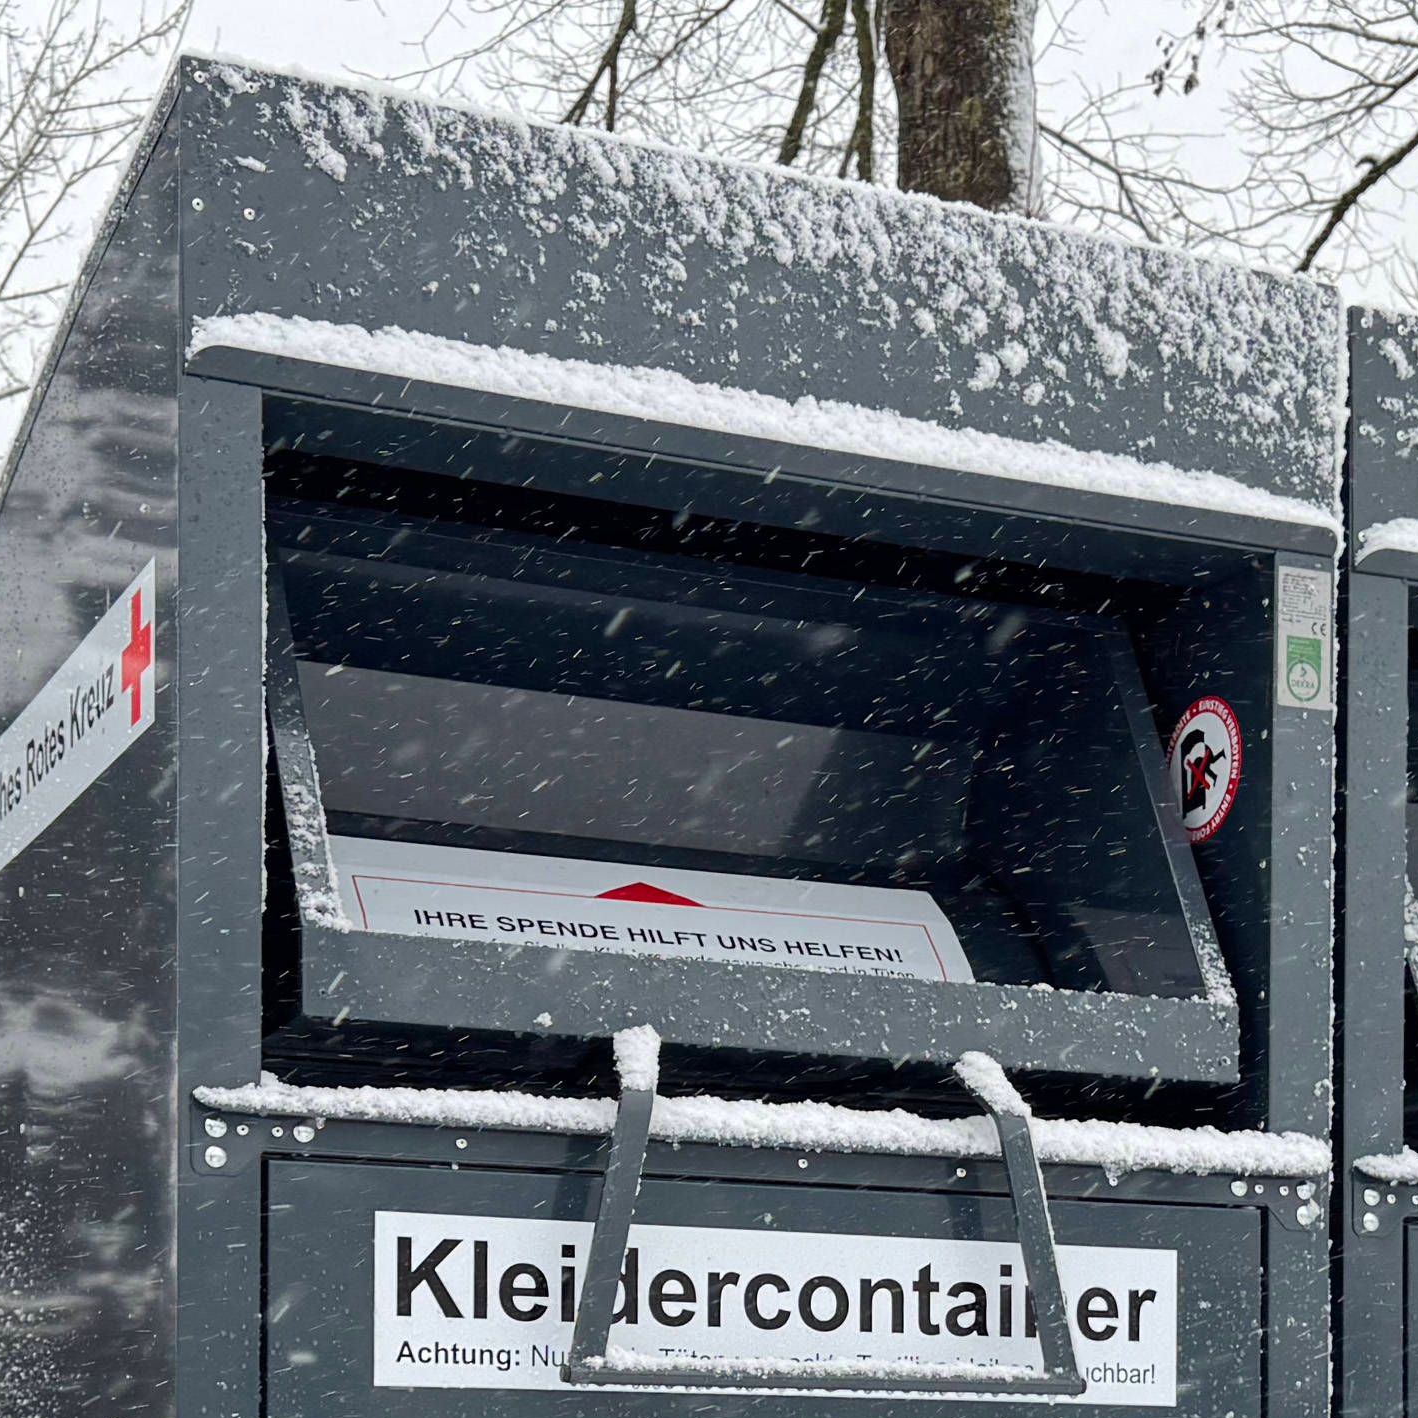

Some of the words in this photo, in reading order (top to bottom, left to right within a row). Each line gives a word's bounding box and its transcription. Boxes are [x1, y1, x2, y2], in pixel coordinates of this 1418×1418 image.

[25, 719, 65, 795] Rotes
[69, 663, 115, 748] Kreuz
[413, 909, 488, 930] IHRE
[495, 916, 620, 940] SPENDE
[627, 926, 707, 947] HILFT
[716, 934, 777, 953] UNS
[783, 939, 904, 963] HELFEN!
[395, 1340, 521, 1372] Achtung:
[530, 1344, 570, 1368] Nu
